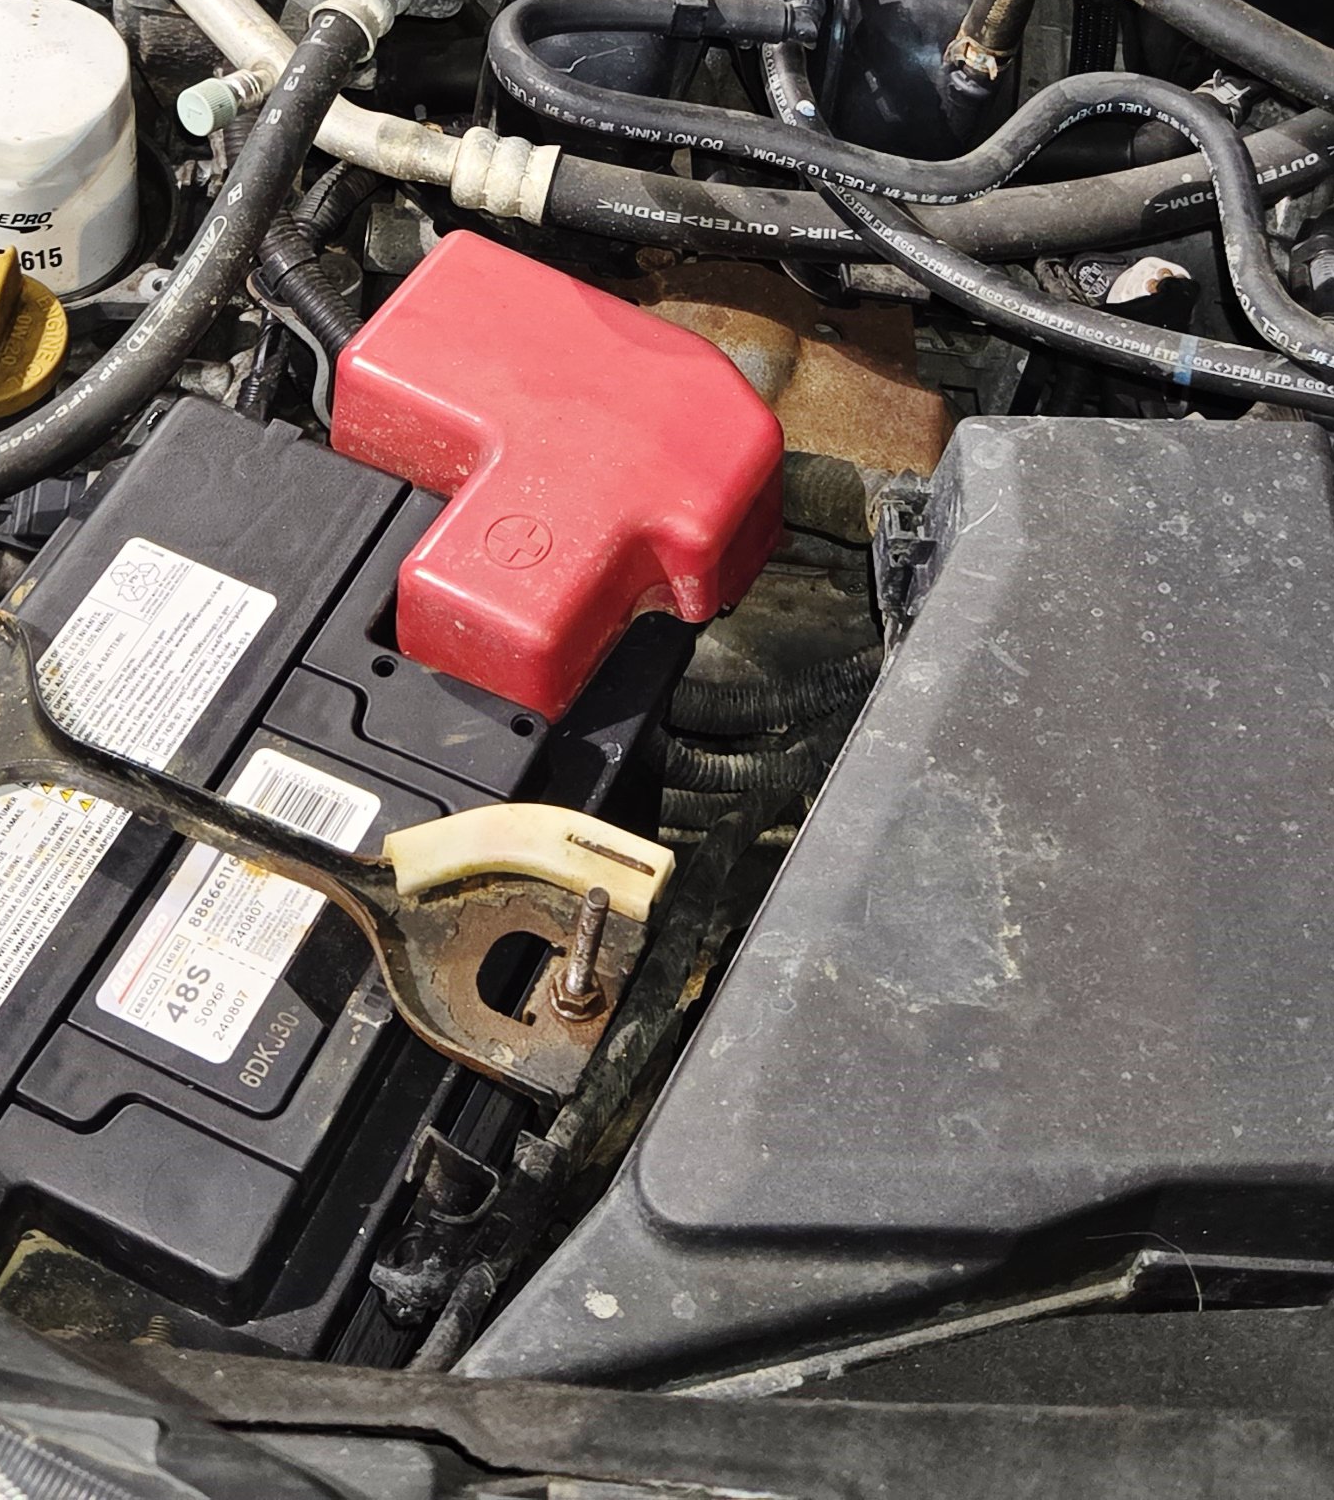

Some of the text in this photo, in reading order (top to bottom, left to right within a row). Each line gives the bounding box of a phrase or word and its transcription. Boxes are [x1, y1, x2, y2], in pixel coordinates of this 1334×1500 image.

[667, 131, 698, 149] NOT
[701, 137, 724, 151] DO
[11, 211, 53, 225] PRO
[37, 292, 65, 363] ENGINE
[98, 356, 124, 383] HP
[49, 648, 60, 659] OF
[53, 688, 71, 709] OPEN
[5, 879, 19, 894] OU
[13, 867, 28, 883] DES
[17, 850, 55, 899] QUEMADURAS
[30, 890, 45, 908] GET
[41, 856, 69, 892] MEDICAL
[65, 837, 82, 858] HELP
[56, 845, 91, 891] CONSULTER
[85, 833, 99, 849] UN
[46, 905, 63, 925] CON
[76, 852, 100, 882] ACUDA
[228, 898, 266, 948] 240807
[104, 909, 171, 999] ACDelco
[161, 937, 185, 969] 140 RC
[133, 975, 161, 1015] 680 CCA
[159, 959, 214, 1026] 48S
[191, 979, 229, 1028] S096P
[211, 988, 250, 1042] 240807
[238, 1010, 300, 1089] 6DKJ30
